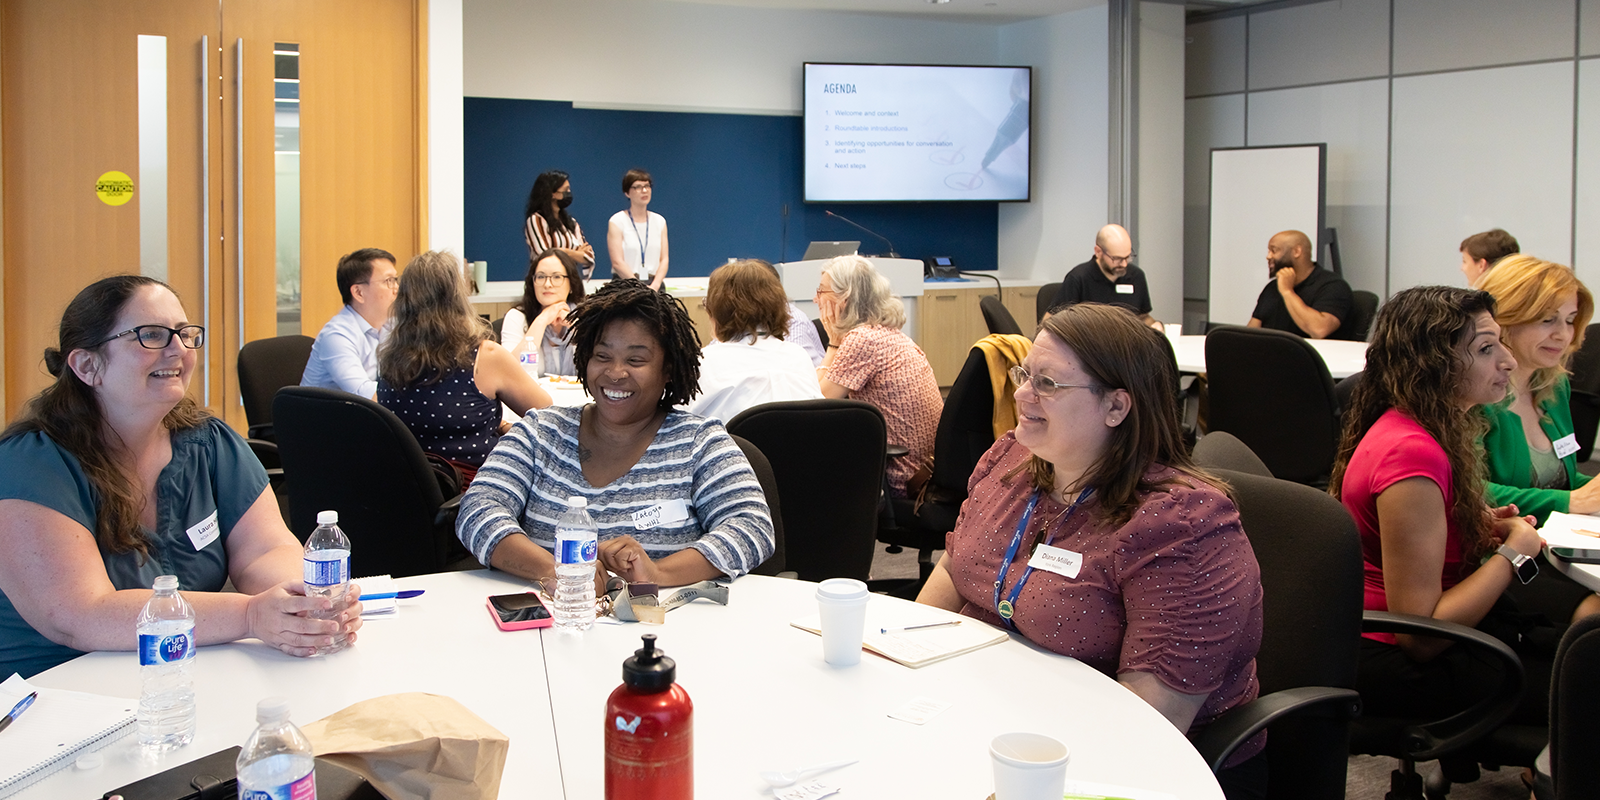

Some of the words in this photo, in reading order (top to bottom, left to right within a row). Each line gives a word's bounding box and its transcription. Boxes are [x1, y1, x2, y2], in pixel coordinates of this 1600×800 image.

[824, 83, 857, 94] AGENDA
[835, 140, 866, 148] Identifying
[867, 140, 905, 148] opportunities
[634, 505, 662, 521] Latoya
[198, 522, 214, 535] Laura
[1041, 552, 1056, 563] Diana
[1056, 555, 1074, 567] Miller
[165, 635, 185, 646] Pure
[167, 643, 184, 654] Life
[244, 789, 268, 800] Pure
